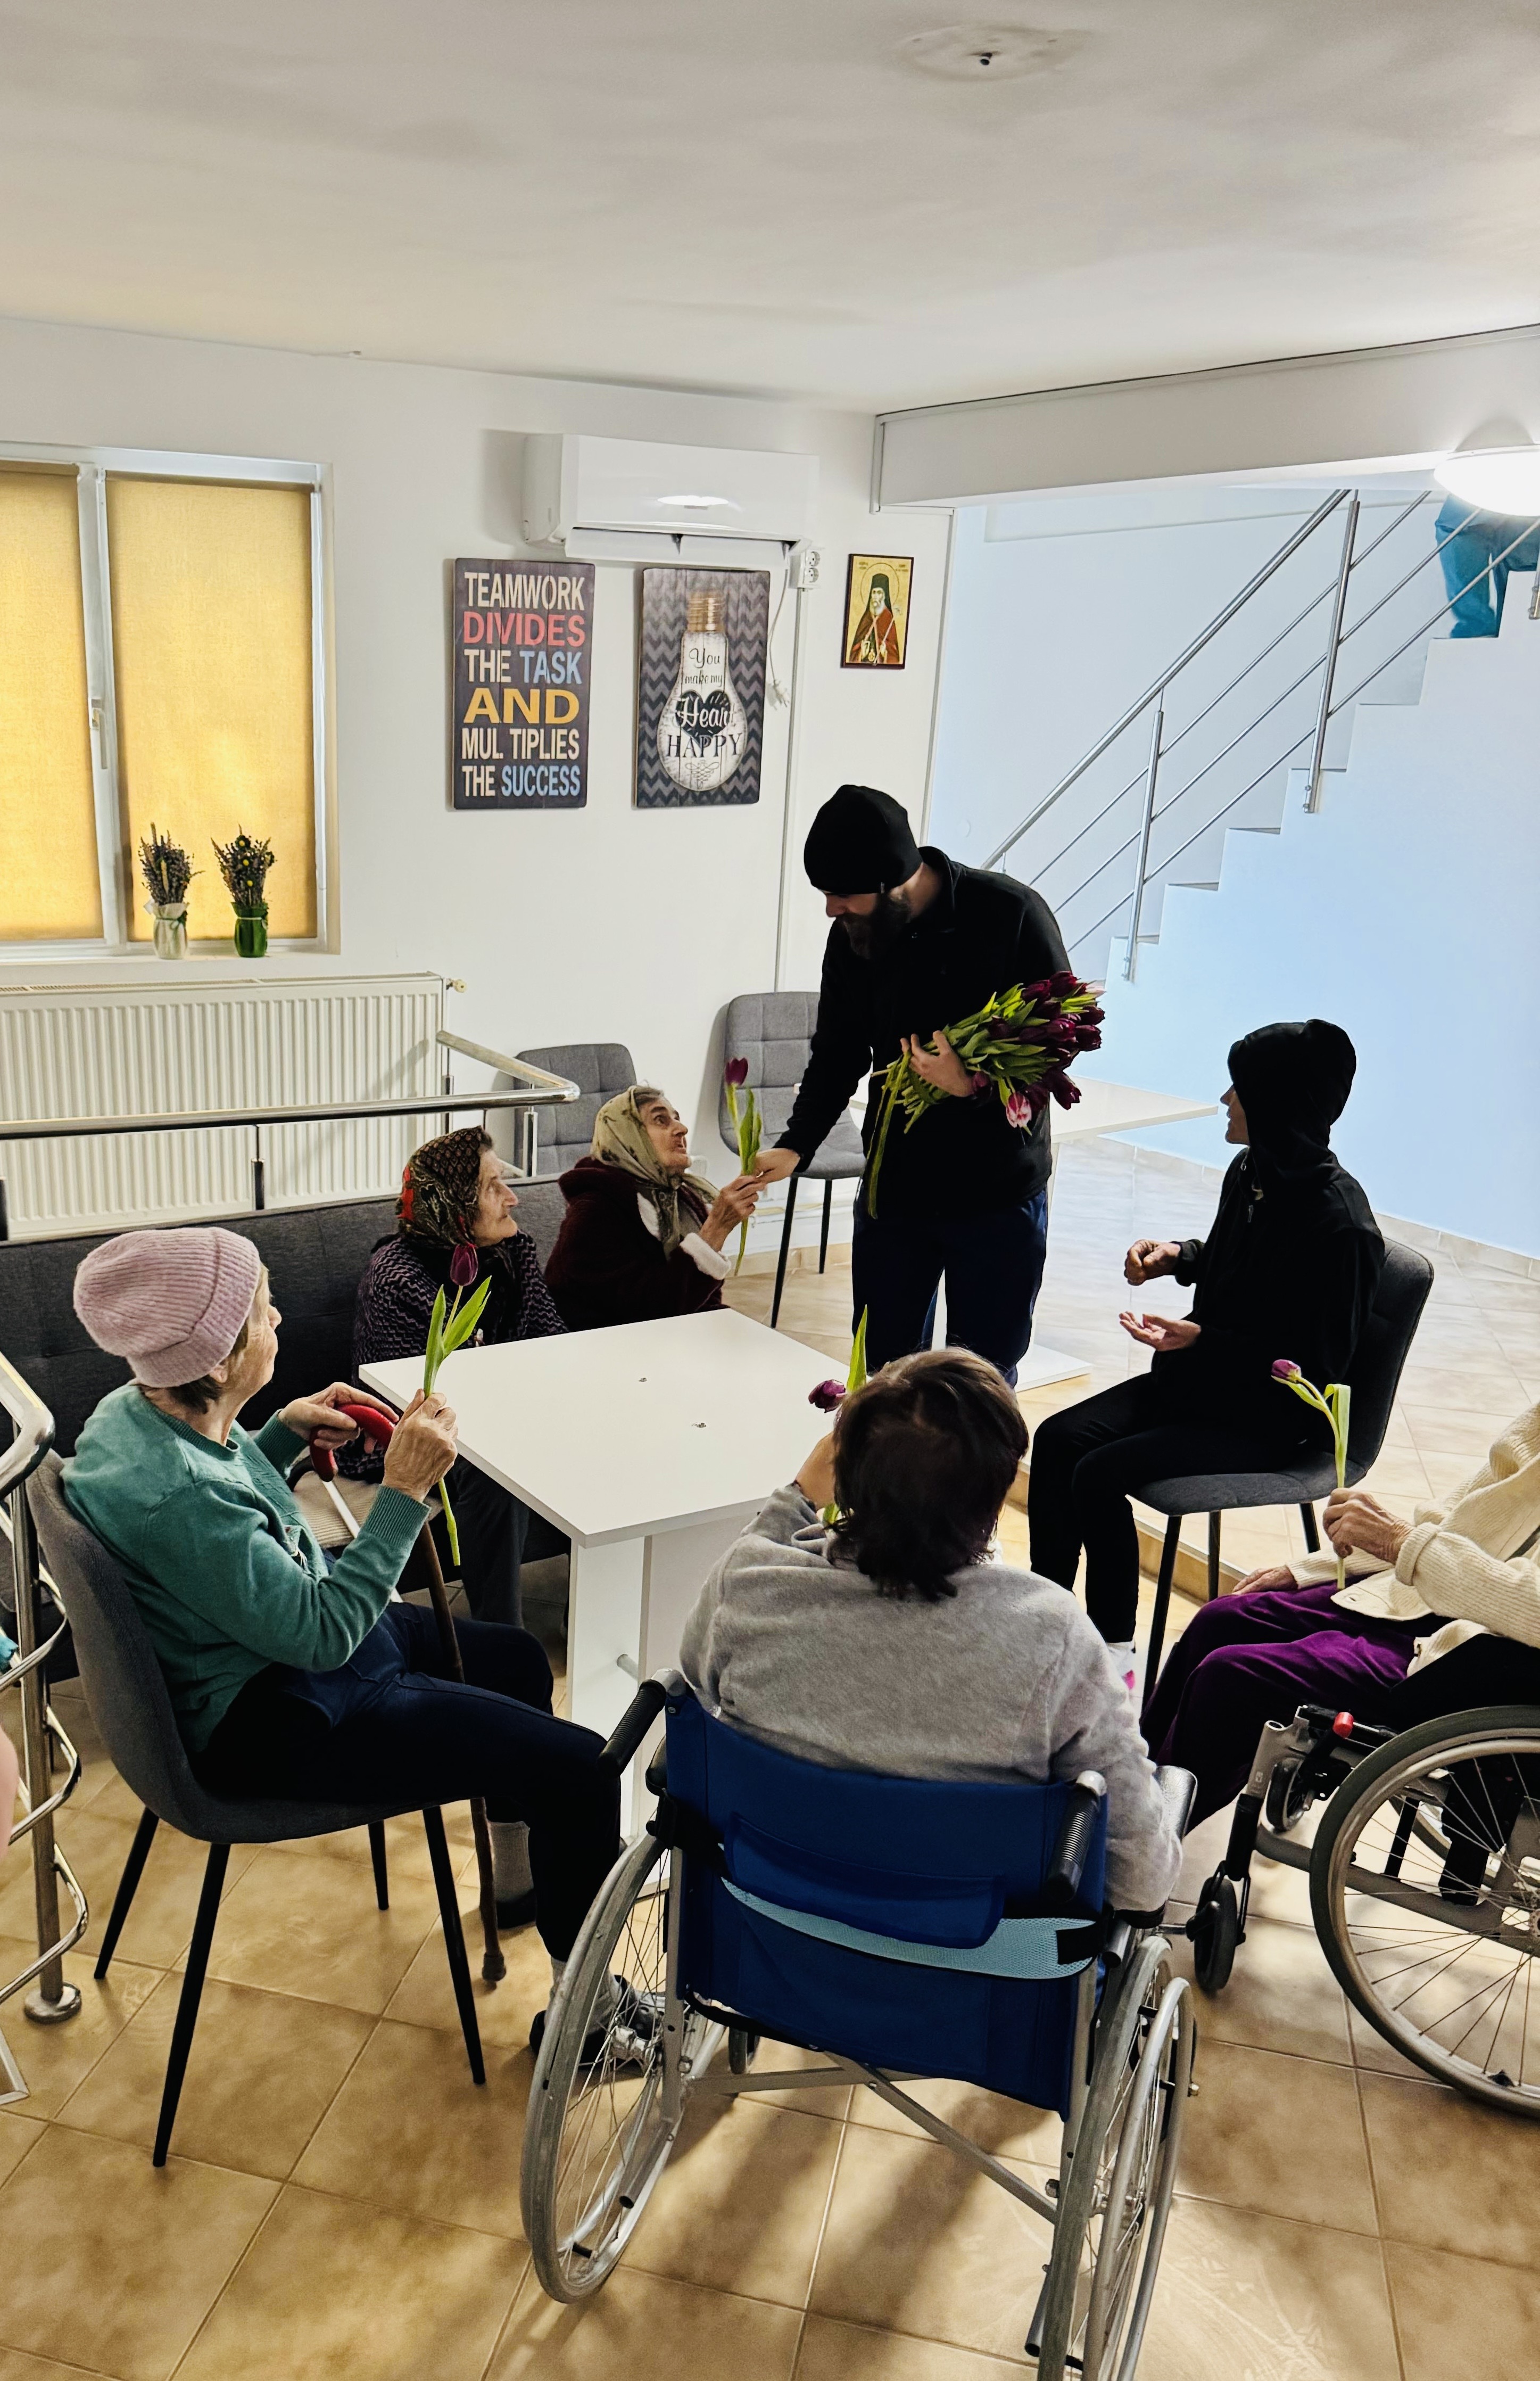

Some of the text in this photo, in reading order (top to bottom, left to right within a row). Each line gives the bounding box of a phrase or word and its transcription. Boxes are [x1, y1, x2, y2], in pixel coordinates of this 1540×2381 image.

[465, 572, 585, 611] TEAMWORK
[463, 612, 585, 647] DIVIDES
[464, 649, 582, 684] THE TASK
[689, 648, 721, 669] You
[684, 671, 724, 688] make my
[463, 688, 579, 724] AND
[673, 697, 735, 728] Heart
[667, 732, 743, 758] HAPPY
[462, 764, 581, 797] THE SUCCESS
